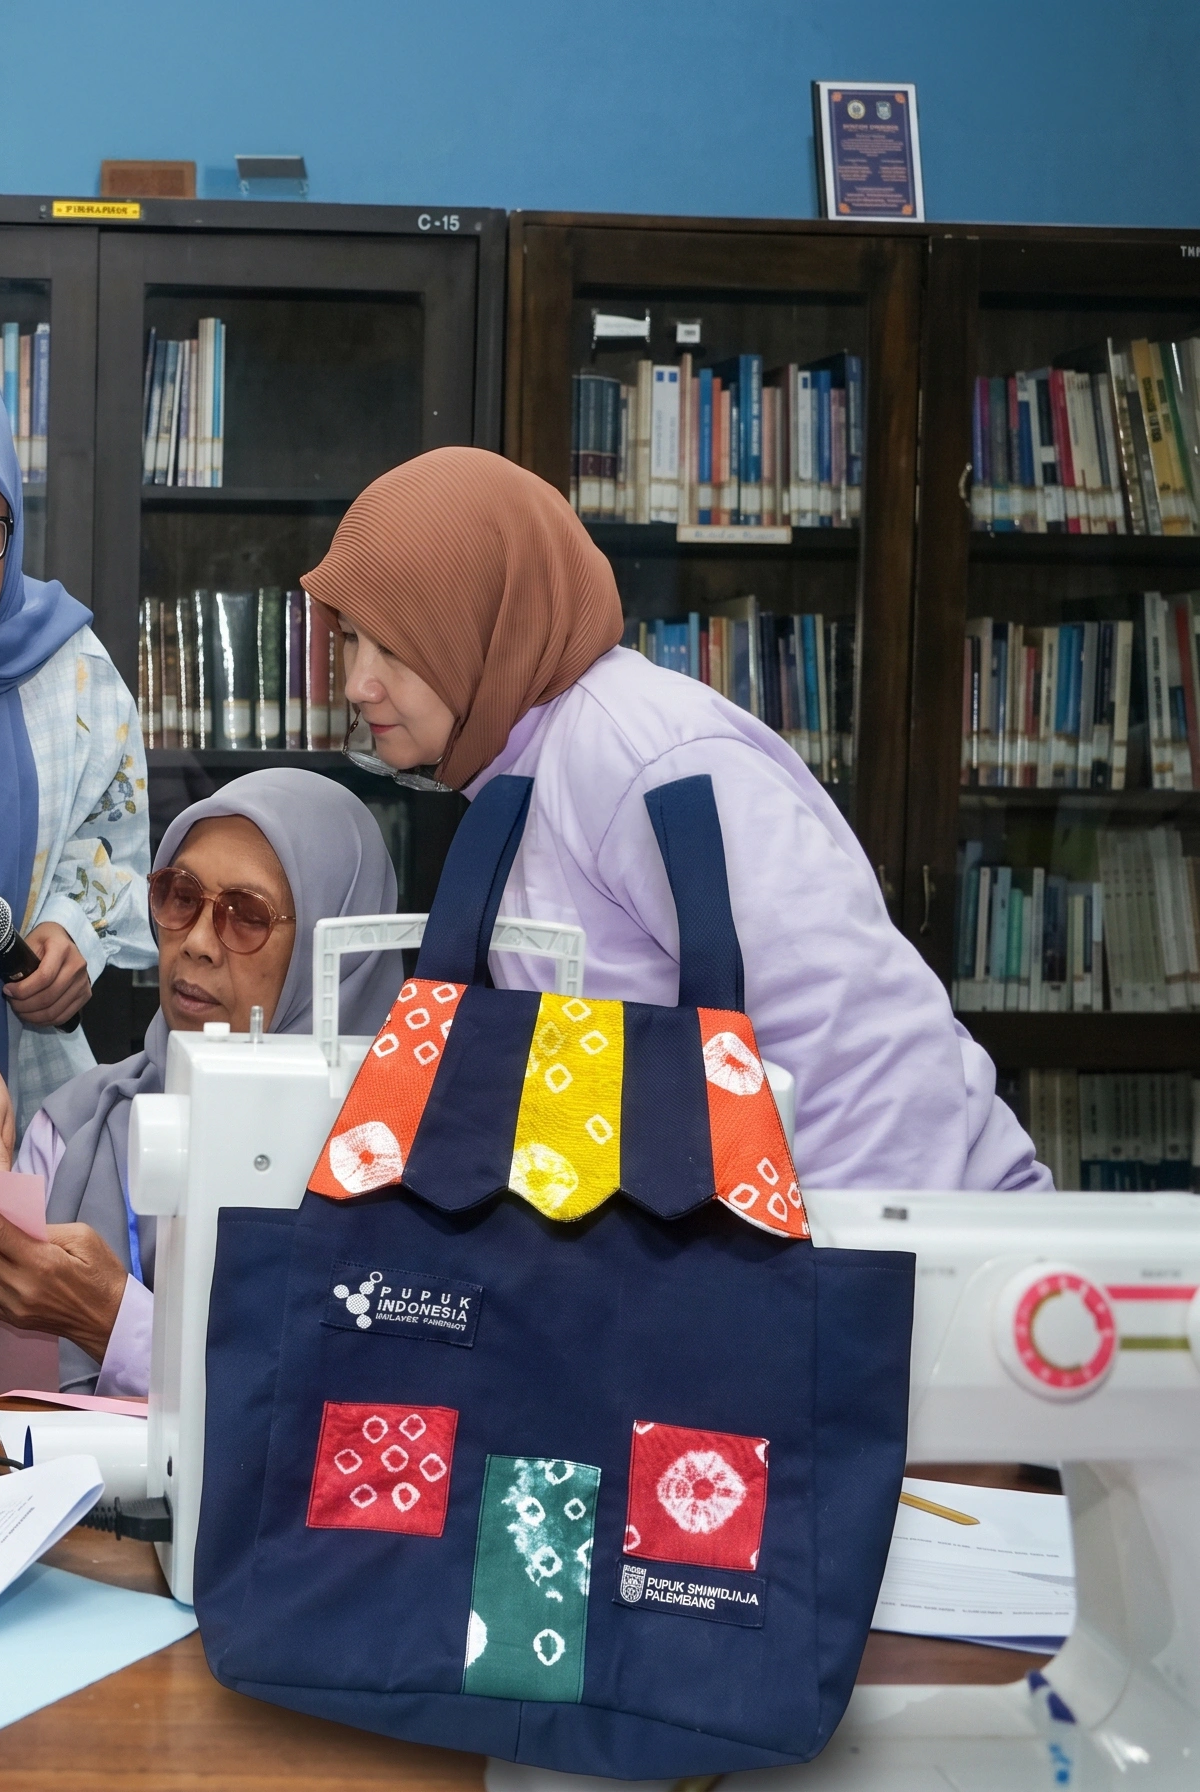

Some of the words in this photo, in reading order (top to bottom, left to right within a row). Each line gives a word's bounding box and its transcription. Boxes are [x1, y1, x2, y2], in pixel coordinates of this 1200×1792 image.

[417, 213, 460, 231] C-15
[380, 1286, 472, 1309] PUPUK
[377, 1299, 468, 1323] INDONESIA
[646, 1577, 685, 1593] PUPUK
[645, 1588, 716, 1610] PALEMBANG
